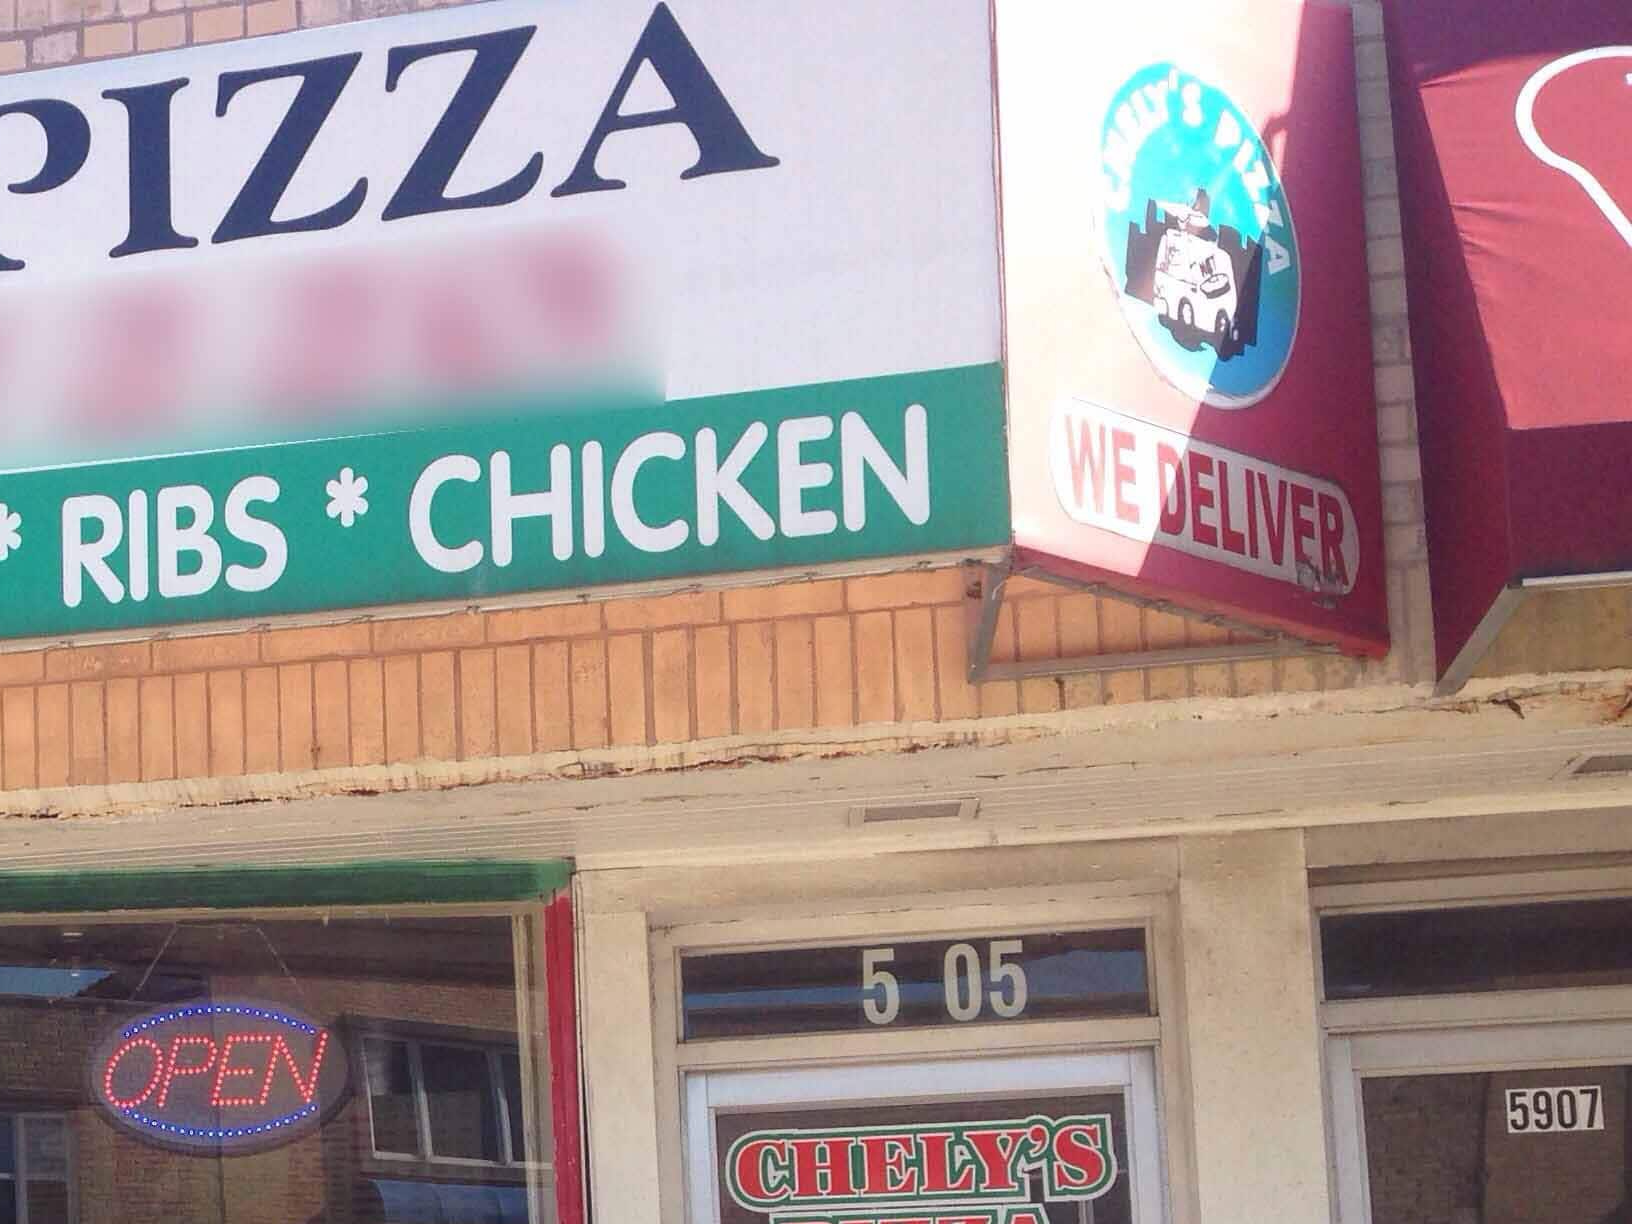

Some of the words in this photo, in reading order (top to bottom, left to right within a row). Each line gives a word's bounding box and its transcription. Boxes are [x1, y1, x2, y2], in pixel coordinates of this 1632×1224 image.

[1214, 109, 1290, 274] PIZZA
[61, 475, 288, 606] RIBS
[408, 403, 931, 573] CHICKEN
[1065, 411, 1140, 525] WE
[1156, 440, 1350, 587] DELIVER
[104, 1029, 329, 1108] OPEN
[1508, 1088, 1601, 1130] 5907
[732, 1119, 1106, 1205] CHELY'S
